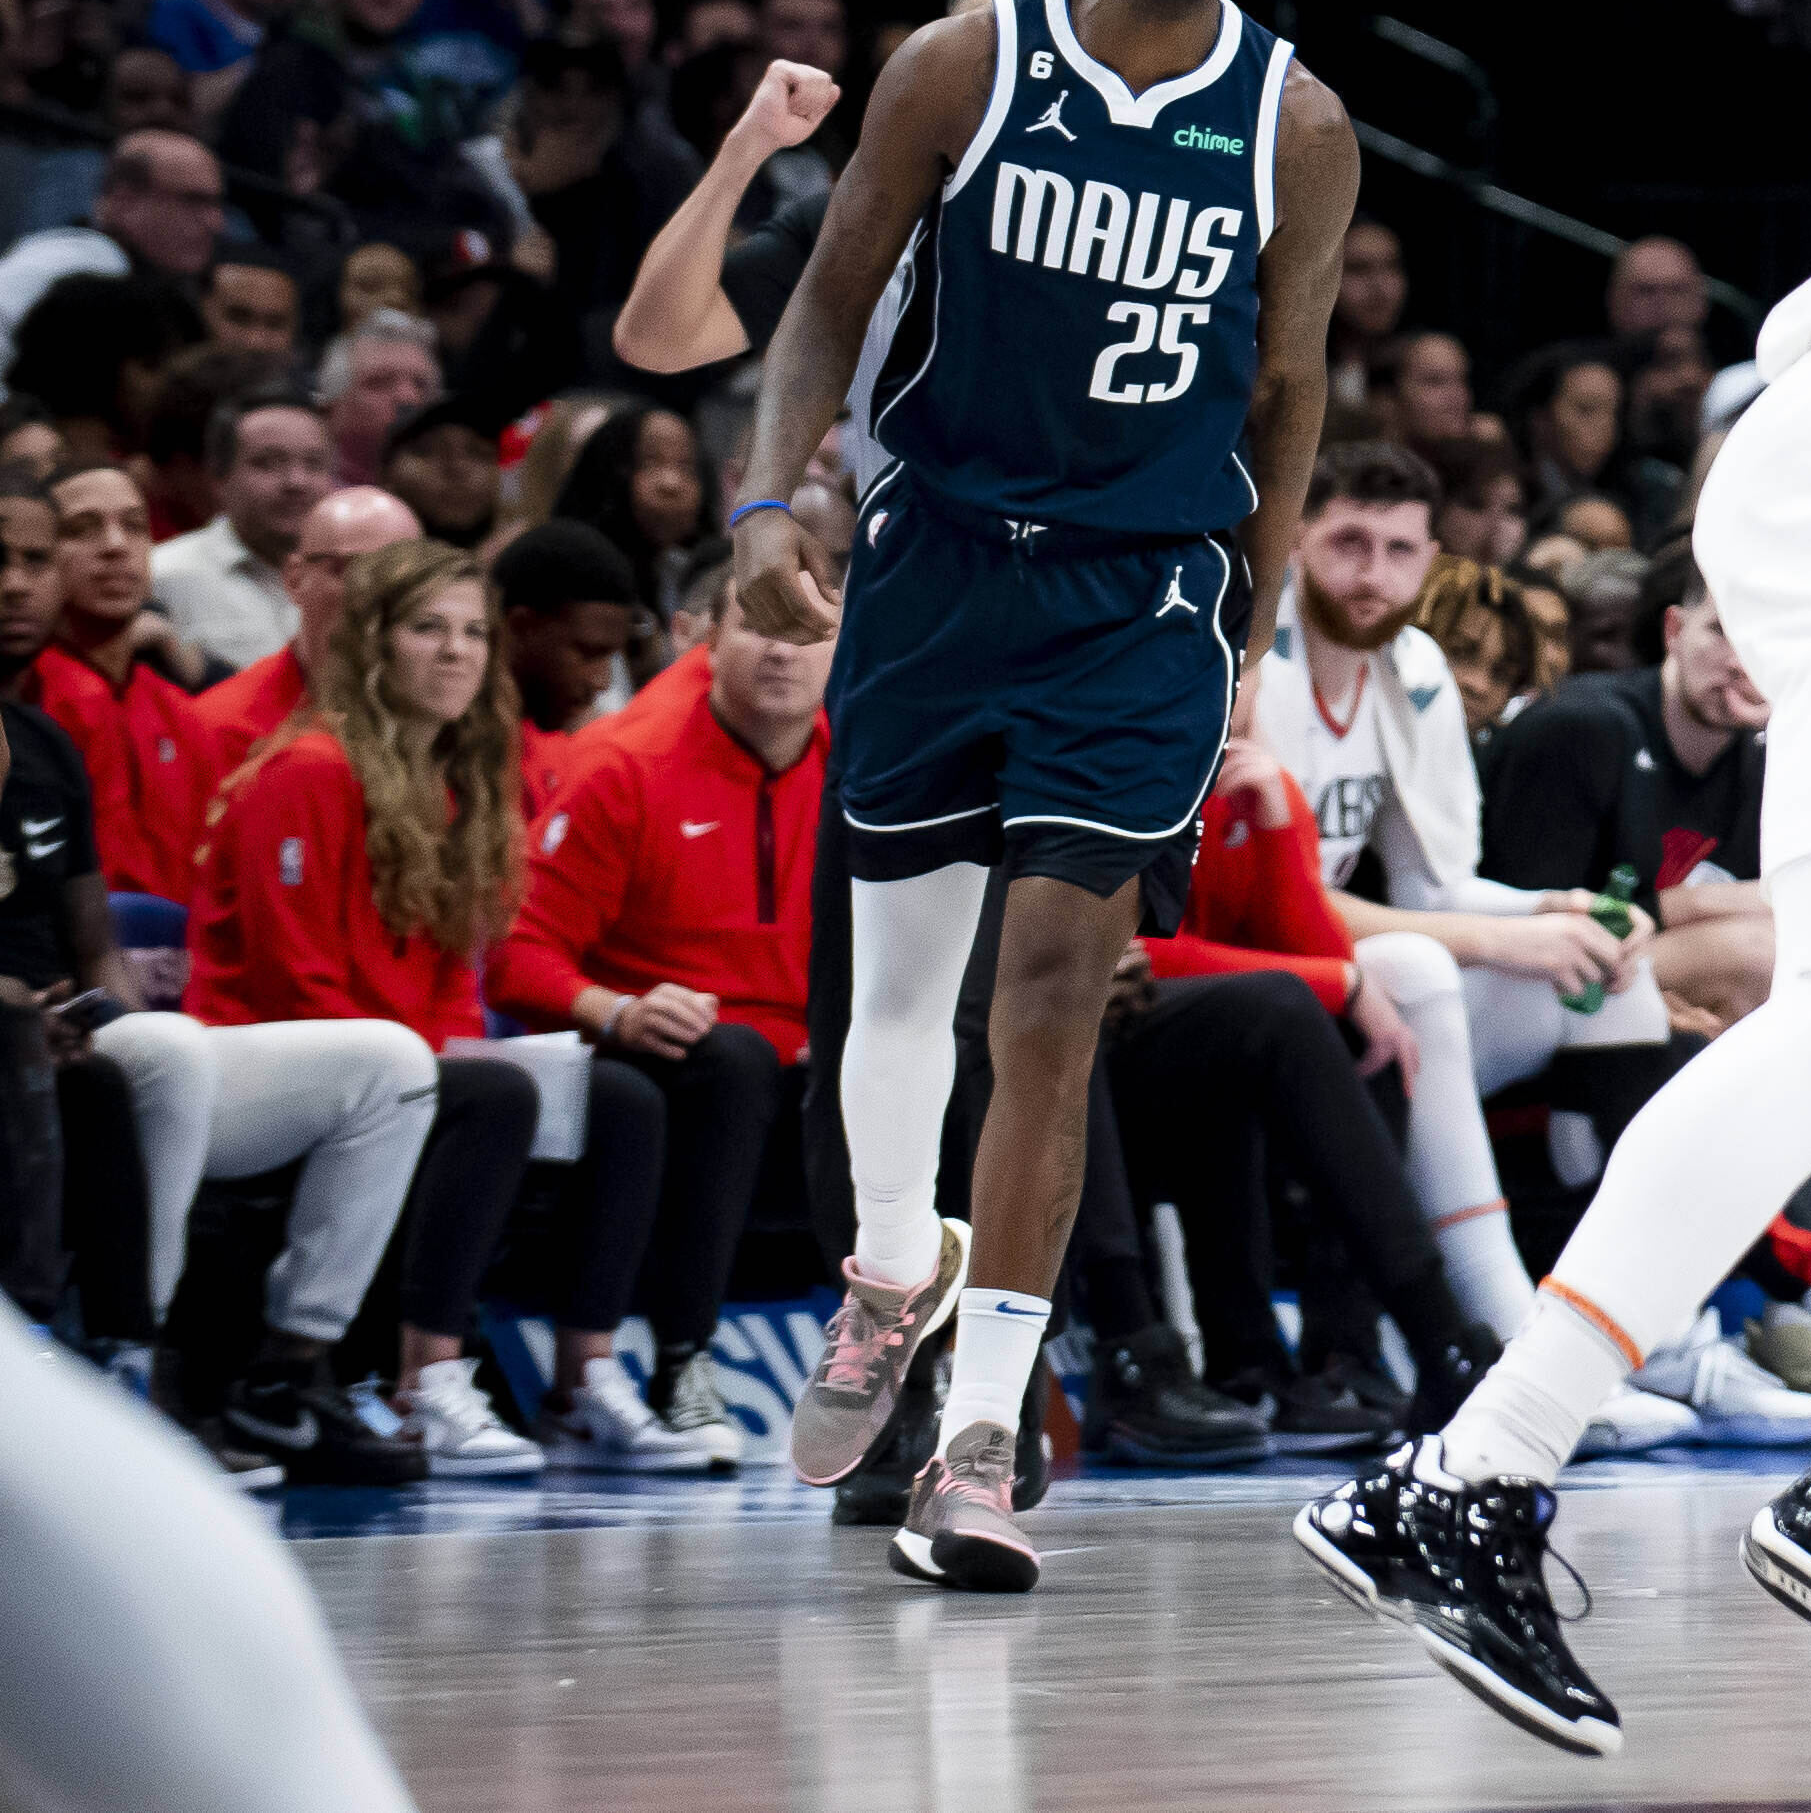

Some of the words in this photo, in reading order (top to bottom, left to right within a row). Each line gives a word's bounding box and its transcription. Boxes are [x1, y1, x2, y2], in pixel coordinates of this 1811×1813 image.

[1029, 50, 1055, 80] 6
[1173, 124, 1245, 156] chime
[991, 161, 1244, 298] MAVS
[1088, 301, 1211, 404] 25
